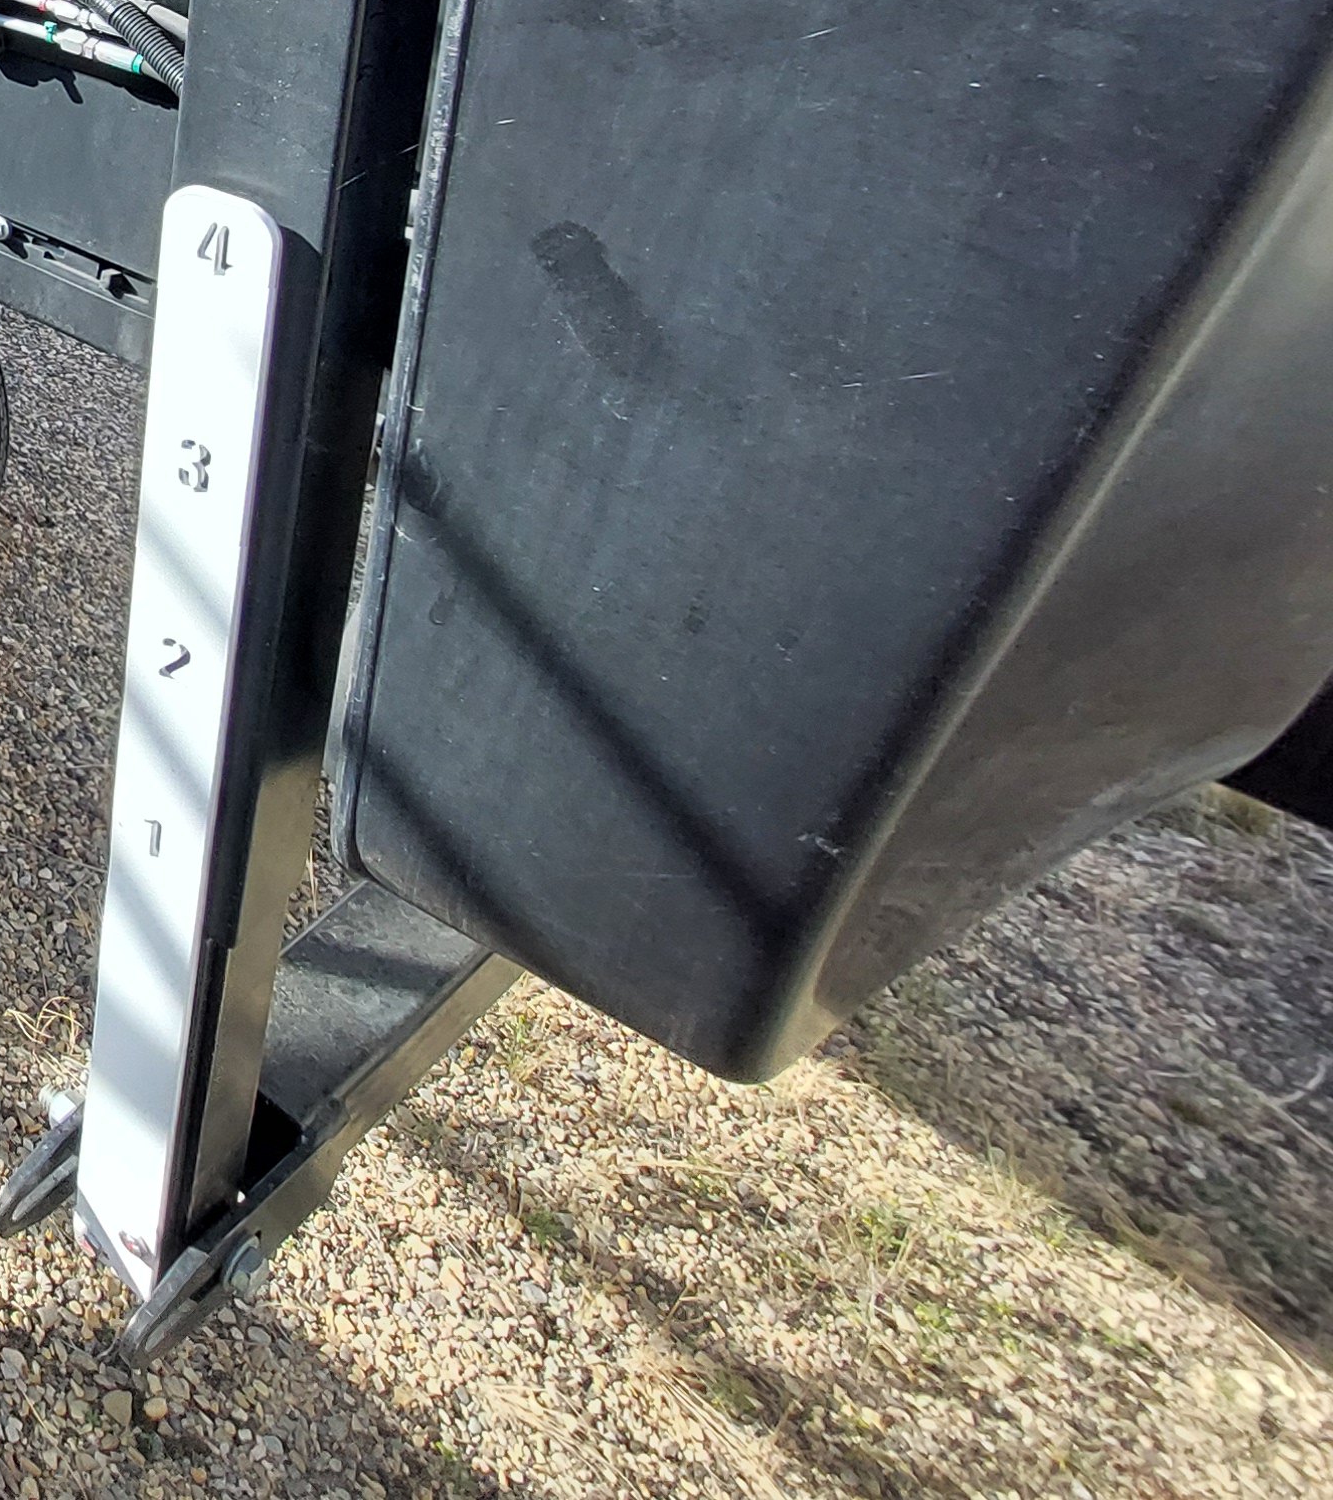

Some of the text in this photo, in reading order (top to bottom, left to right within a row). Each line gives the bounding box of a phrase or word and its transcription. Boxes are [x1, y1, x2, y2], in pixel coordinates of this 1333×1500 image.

[196, 222, 233, 276] 4
[178, 439, 212, 493] 3
[158, 637, 192, 681] 2
[143, 817, 164, 858] 1
